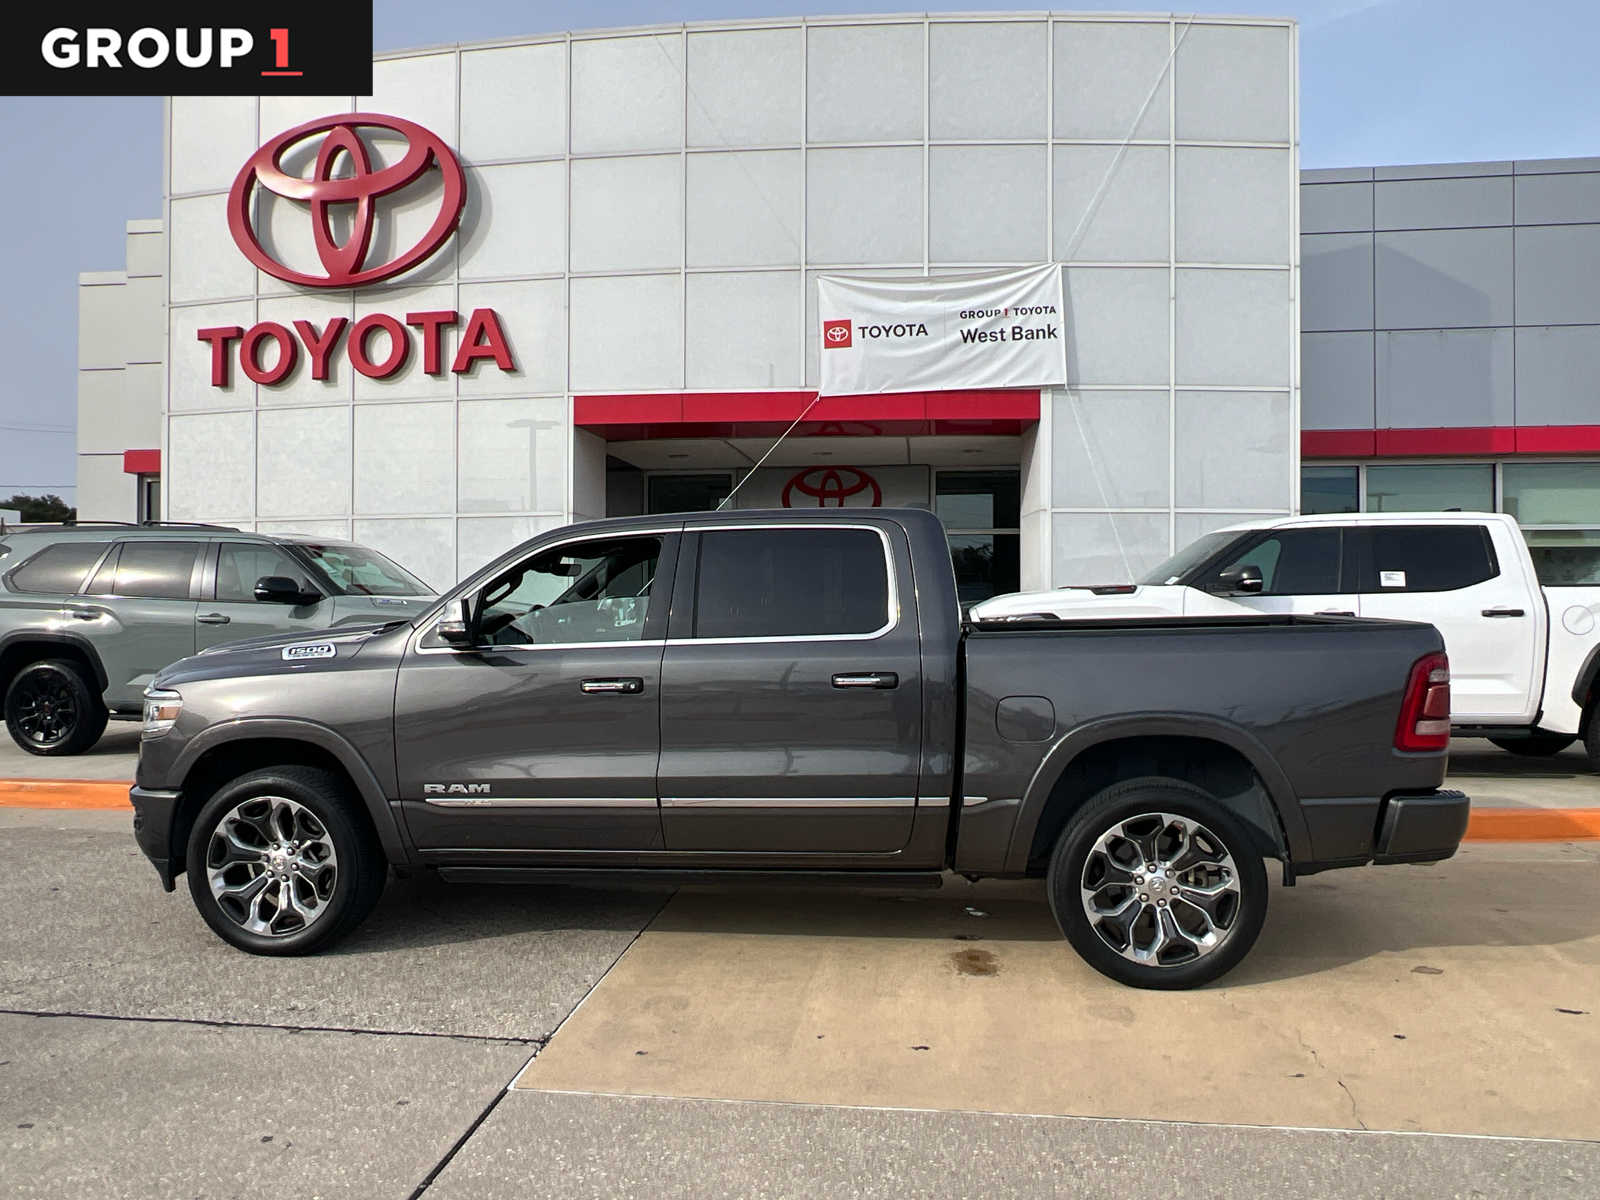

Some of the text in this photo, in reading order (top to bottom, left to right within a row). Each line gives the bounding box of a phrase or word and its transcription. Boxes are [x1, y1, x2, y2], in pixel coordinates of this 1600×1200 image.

[960, 309, 1001, 319] GROUP
[1013, 305, 1056, 316] TOYOTA
[858, 324, 928, 339] TOYOTA
[960, 324, 1058, 343] West Bank
[198, 308, 514, 387] TOYOTA
[289, 646, 329, 655] 1500
[424, 783, 490, 794] RAM
